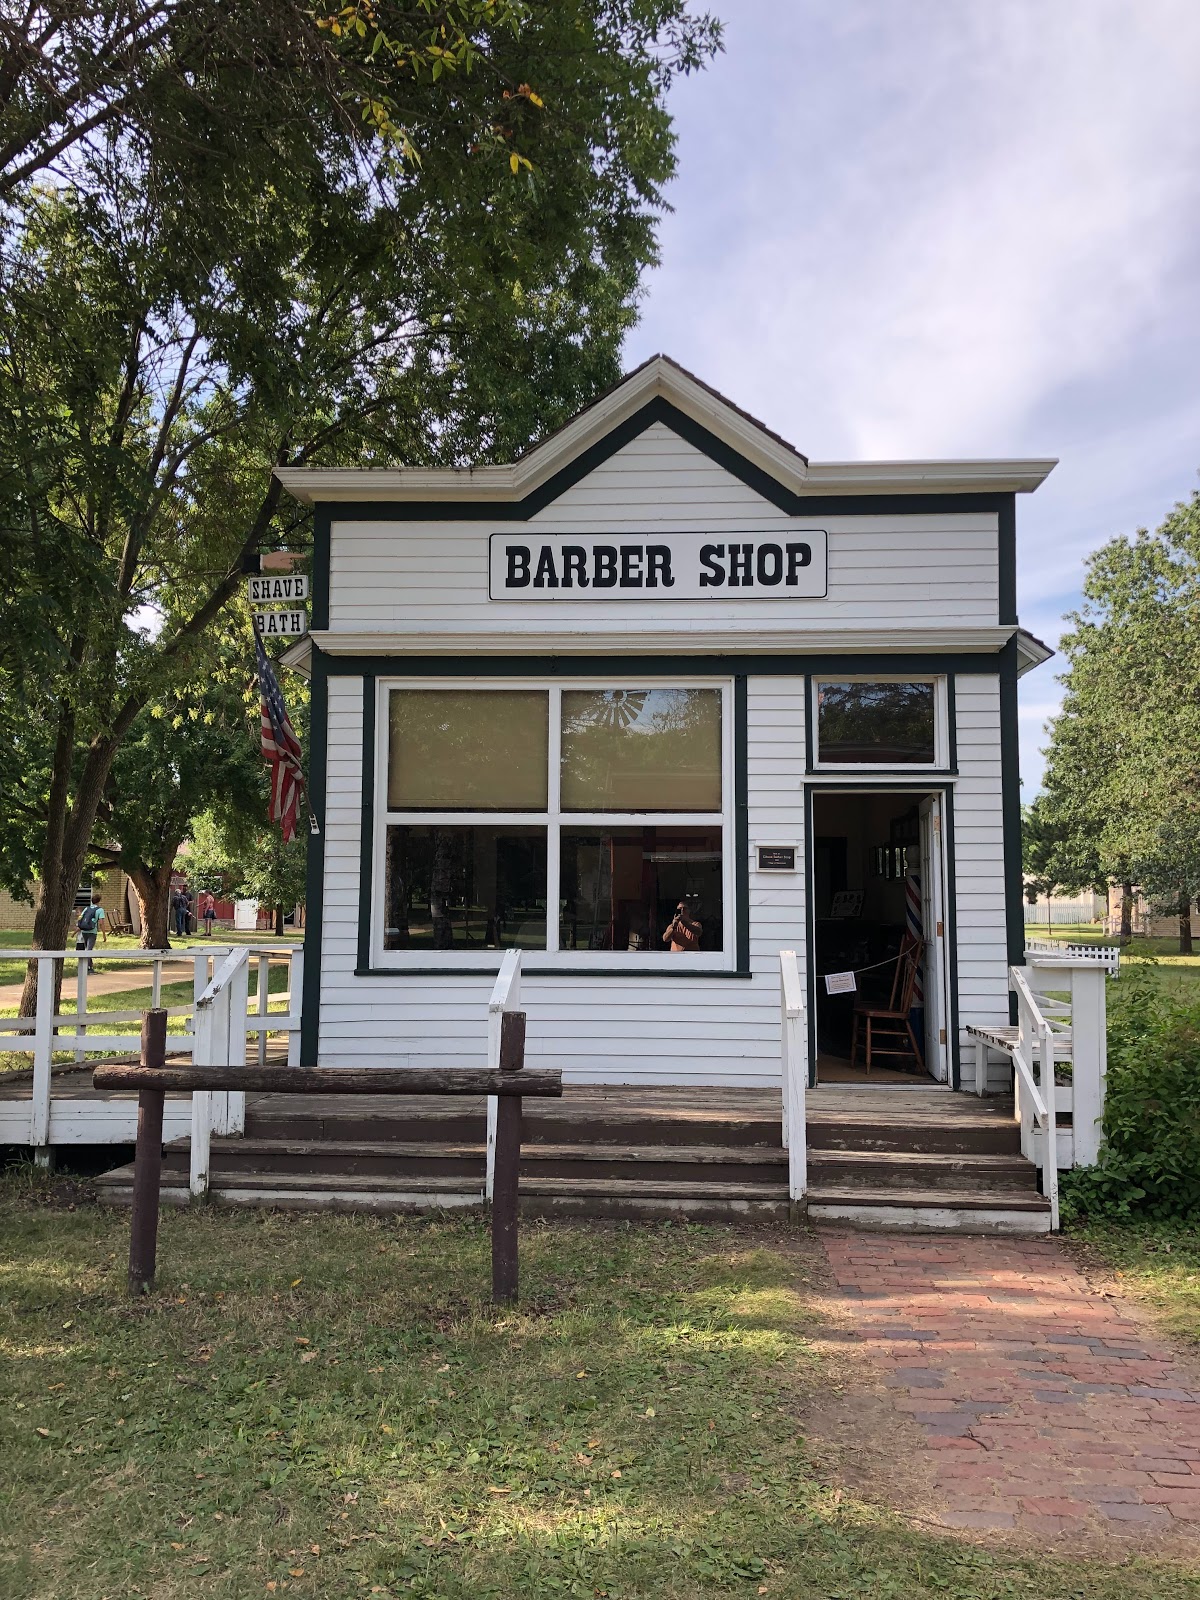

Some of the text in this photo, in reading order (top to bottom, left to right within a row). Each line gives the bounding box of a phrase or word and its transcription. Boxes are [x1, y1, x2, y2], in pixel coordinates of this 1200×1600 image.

[505, 543, 812, 588] BARBER SHOP
[252, 579, 303, 599] SHAVE
[256, 614, 301, 633] BATH
